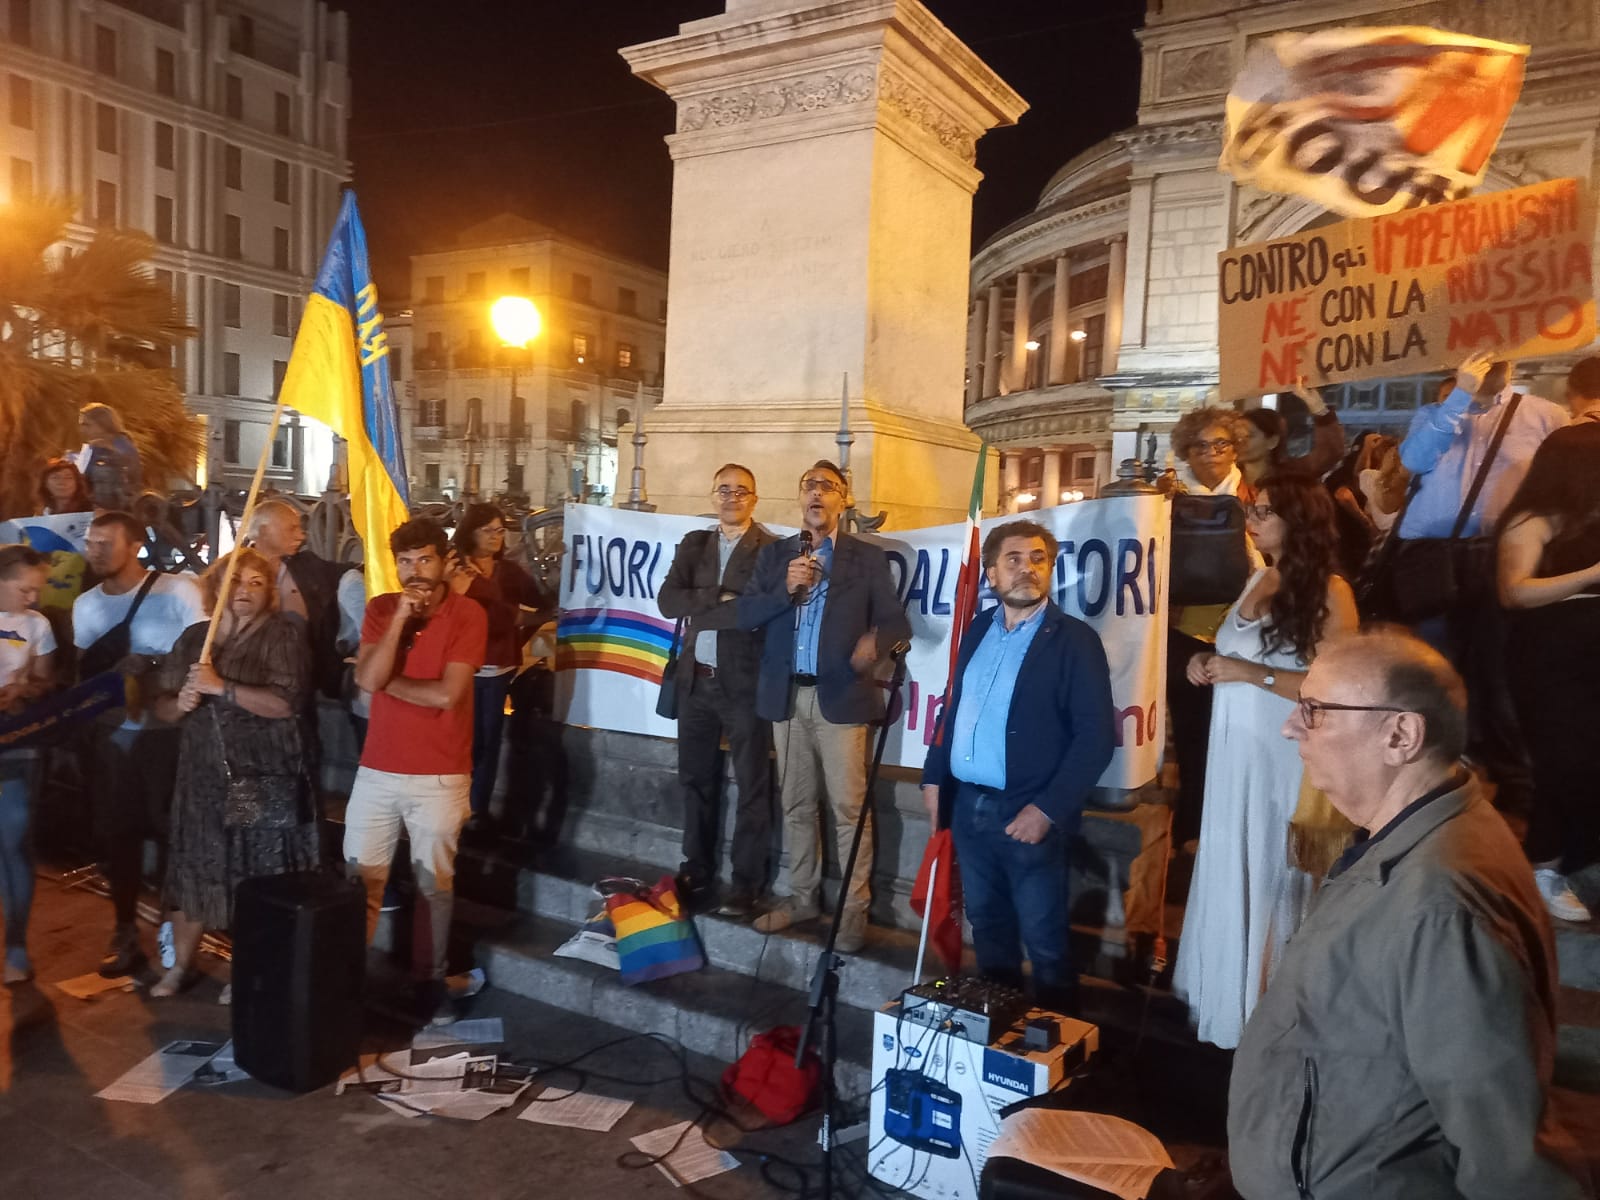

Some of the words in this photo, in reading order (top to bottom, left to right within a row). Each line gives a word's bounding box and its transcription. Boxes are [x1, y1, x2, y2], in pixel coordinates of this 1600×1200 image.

[1220, 239, 1329, 304] CONTRO
[1320, 283, 1375, 326] CON
[1387, 278, 1426, 319] LA
[1316, 332, 1374, 374] CON
[1382, 323, 1428, 362] LA
[1445, 295, 1584, 350] NATO
[569, 534, 662, 599] FUORI
[988, 1072, 1029, 1093] HYUNDAI
